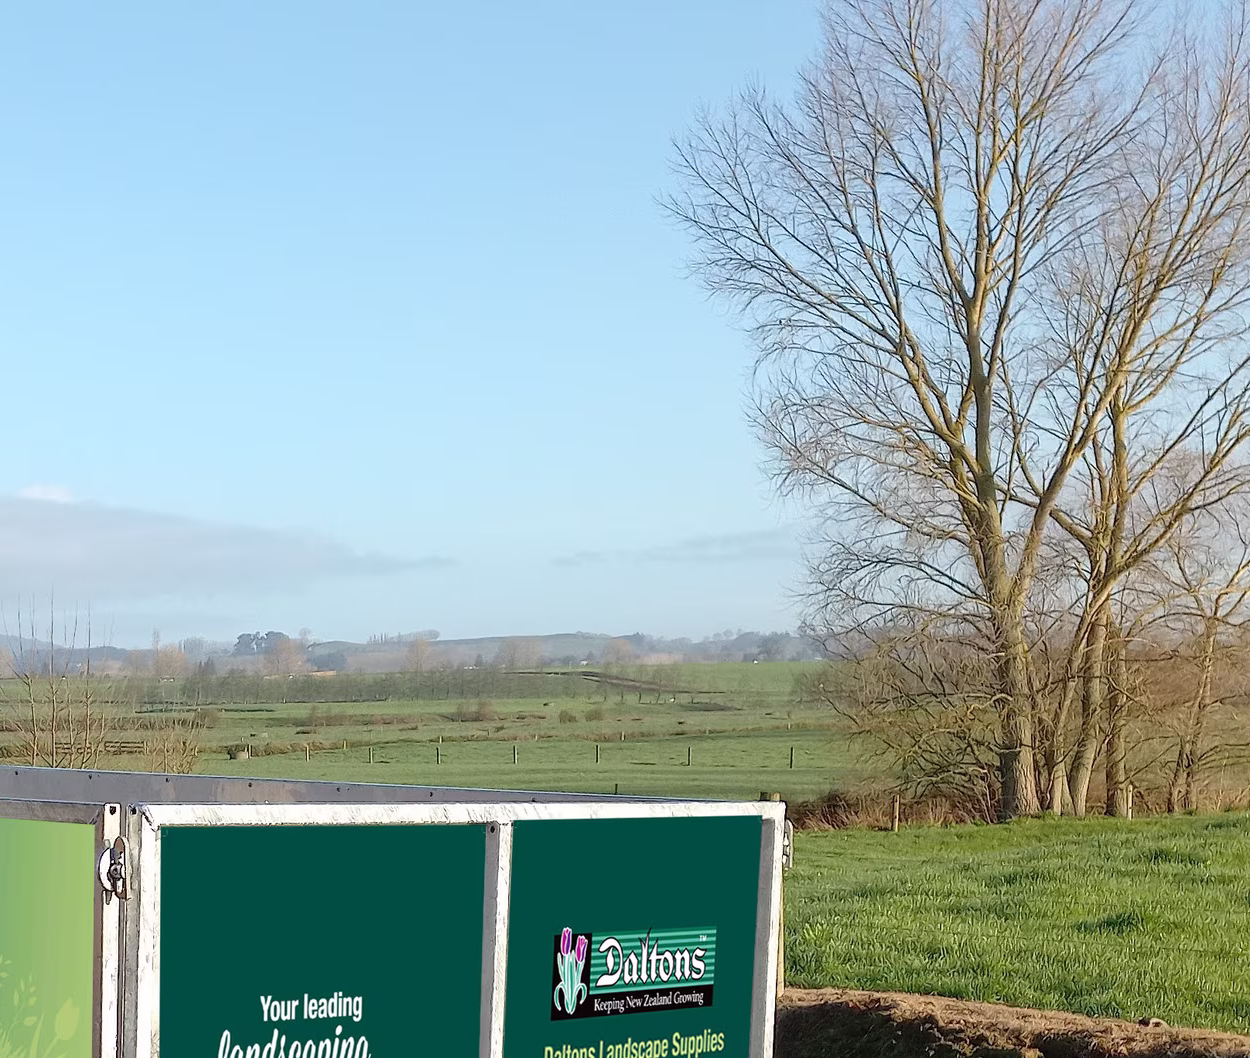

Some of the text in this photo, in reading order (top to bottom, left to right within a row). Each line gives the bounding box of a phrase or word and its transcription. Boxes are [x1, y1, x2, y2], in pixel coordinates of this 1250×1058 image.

[595, 930, 707, 987] Daltons
[260, 991, 363, 1022] Your leading
[594, 991, 704, 1014] Keeping New Zealand Growing
